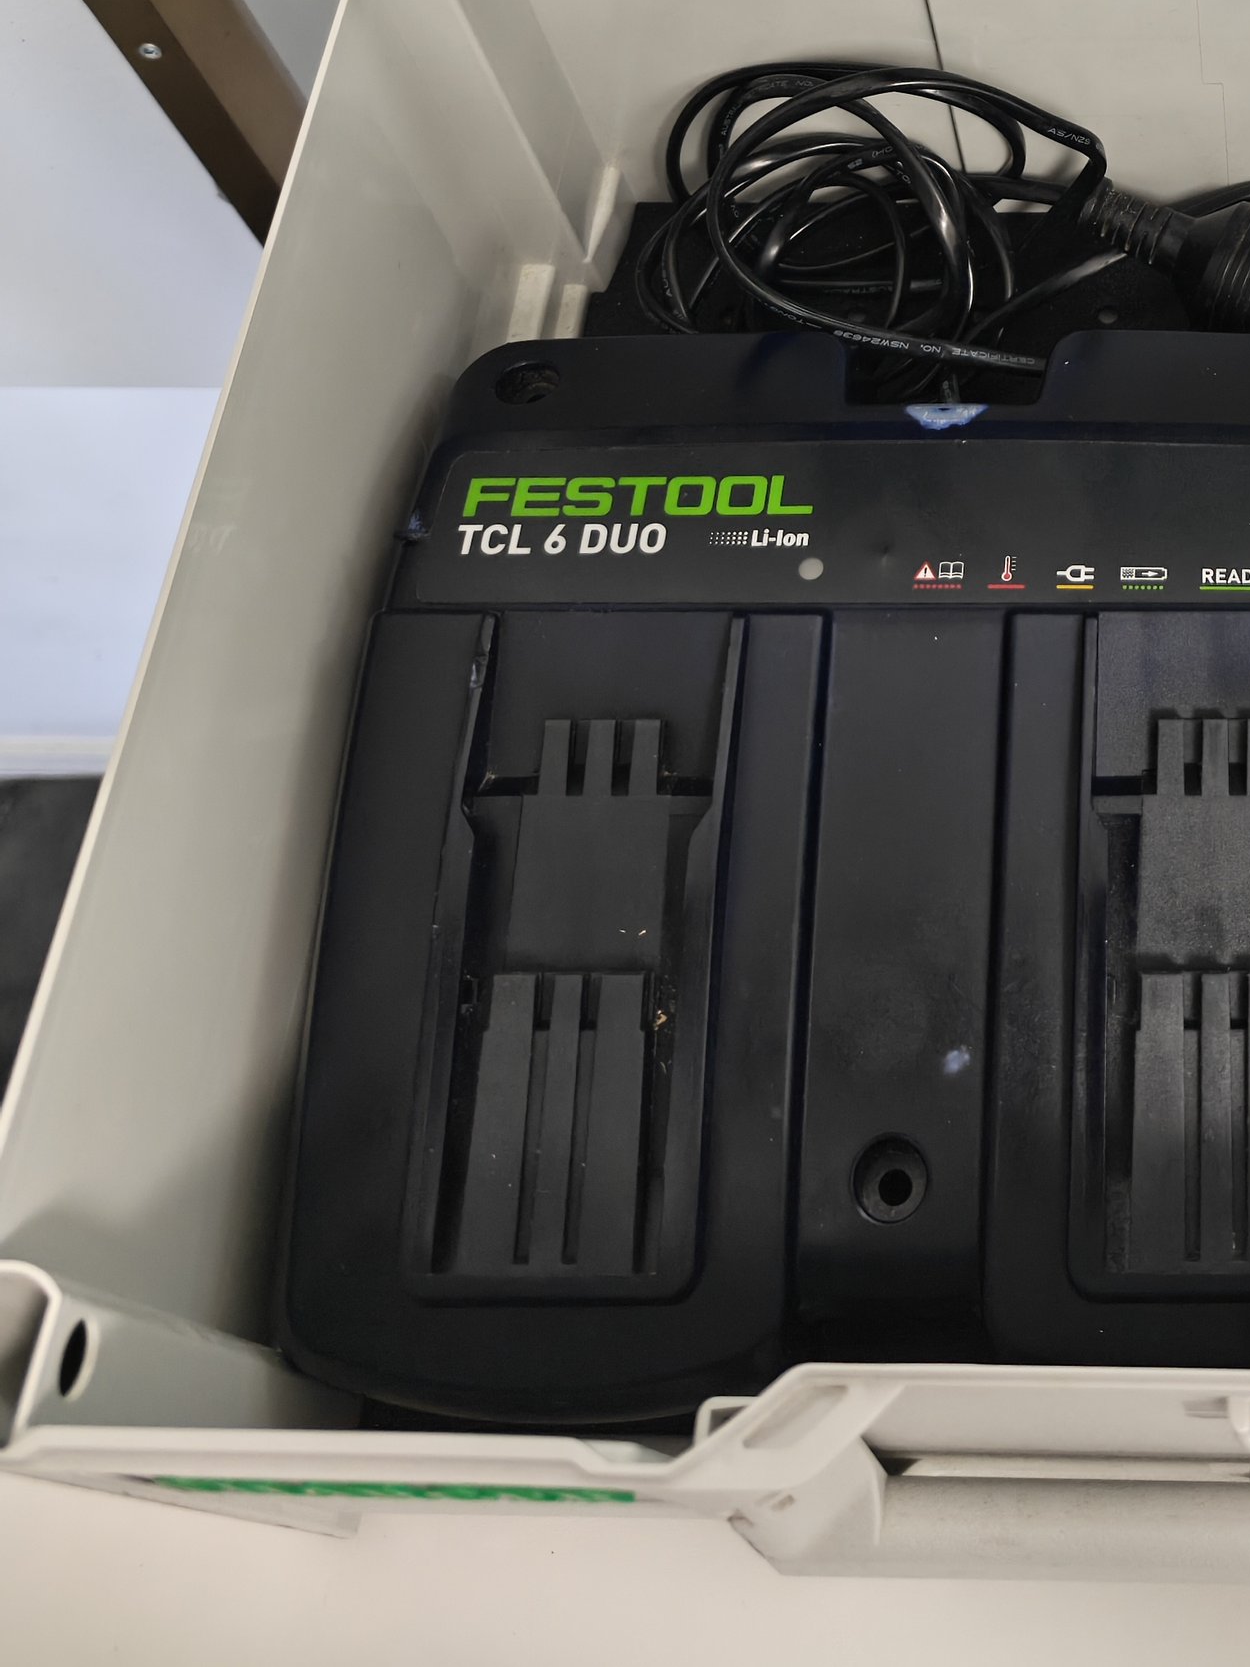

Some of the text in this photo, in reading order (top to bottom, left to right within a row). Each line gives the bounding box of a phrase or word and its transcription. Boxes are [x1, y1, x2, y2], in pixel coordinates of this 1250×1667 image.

[920, 343, 942, 354] NO.
[951, 347, 1036, 365] CERTIFICATE
[462, 475, 813, 517] FESTOOL
[458, 523, 667, 555] TCL 6 DUO
[751, 528, 809, 548] Li-Ion
